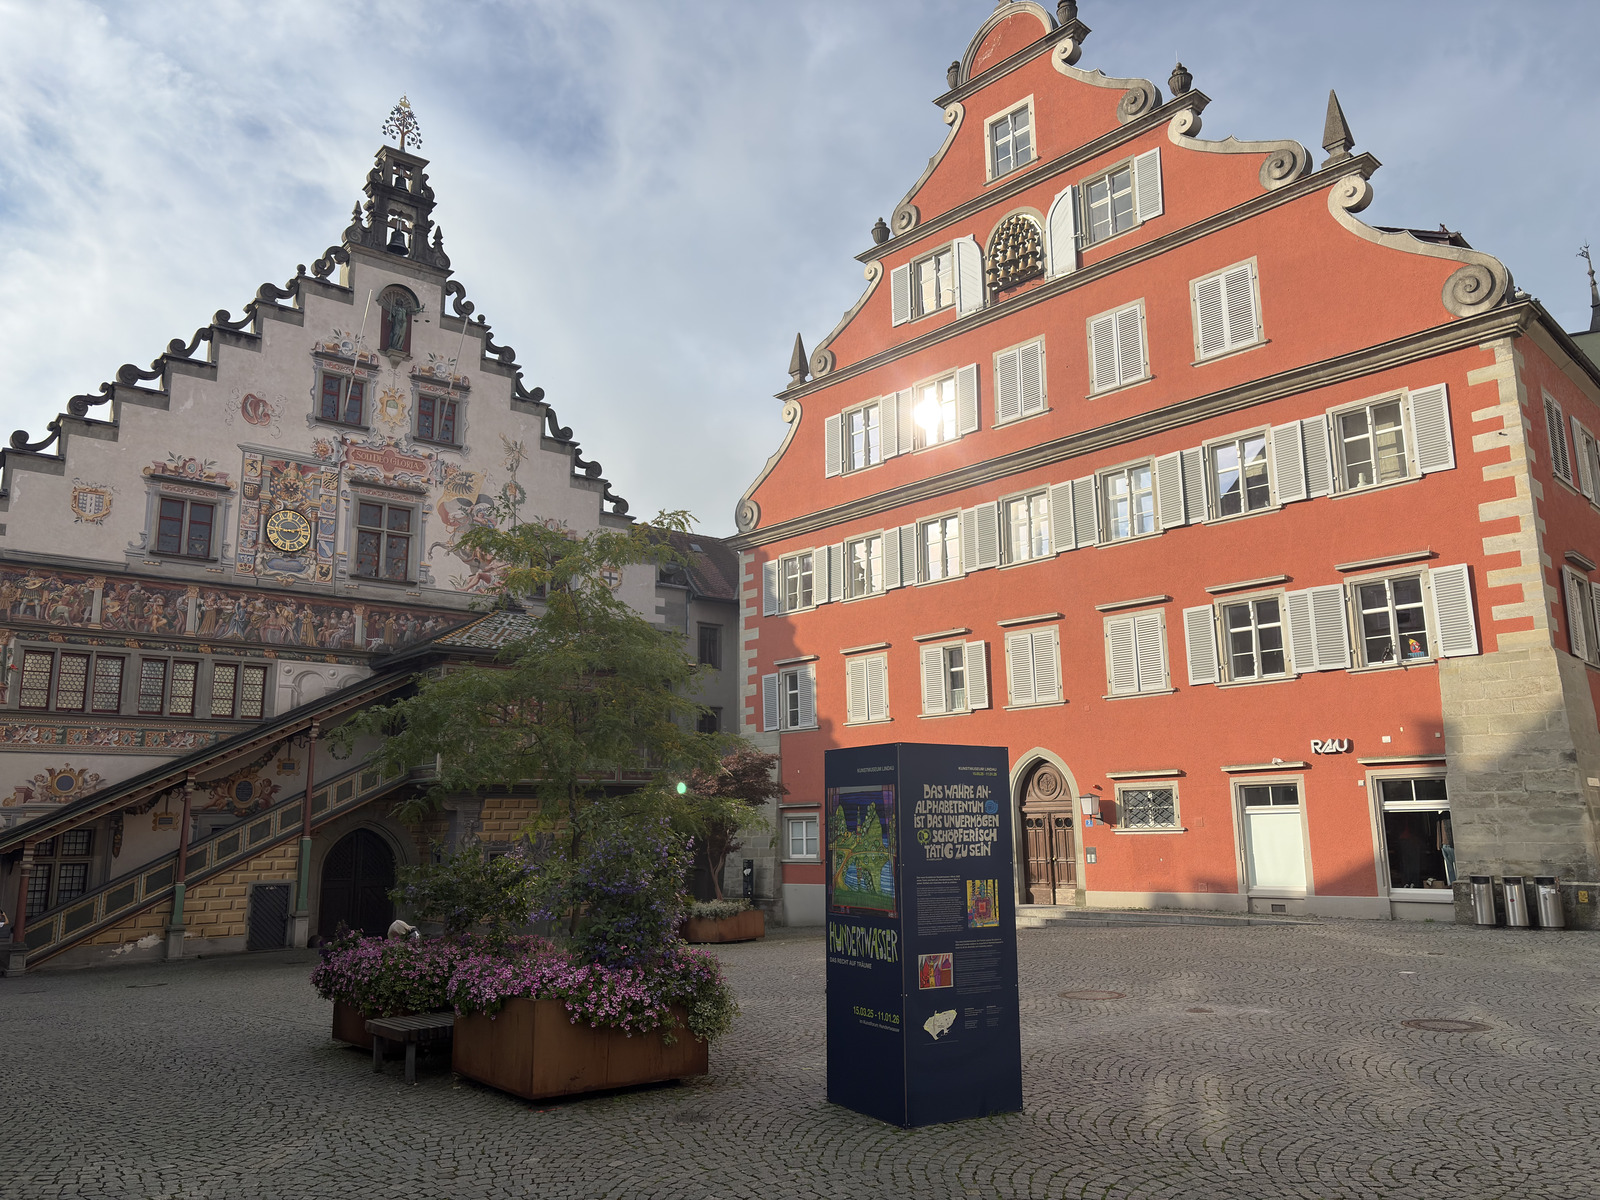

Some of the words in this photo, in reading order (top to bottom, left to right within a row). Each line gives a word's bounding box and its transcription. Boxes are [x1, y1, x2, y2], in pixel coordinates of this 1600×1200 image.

[923, 784, 943, 799] DAS
[944, 784, 974, 799] WAHRE
[976, 784, 992, 799] AN-
[915, 800, 984, 814] ALPHABETENTUM
[927, 815, 942, 828] DAS
[944, 814, 999, 828] UNVERMÖGEN
[924, 843, 953, 859] TÄTIG
[955, 844, 968, 859] ZU
[829, 921, 898, 963] HUNDERTWASSER
[853, 1006, 874, 1018] 15.03.25
[878, 1011, 899, 1024] 11.01.26
